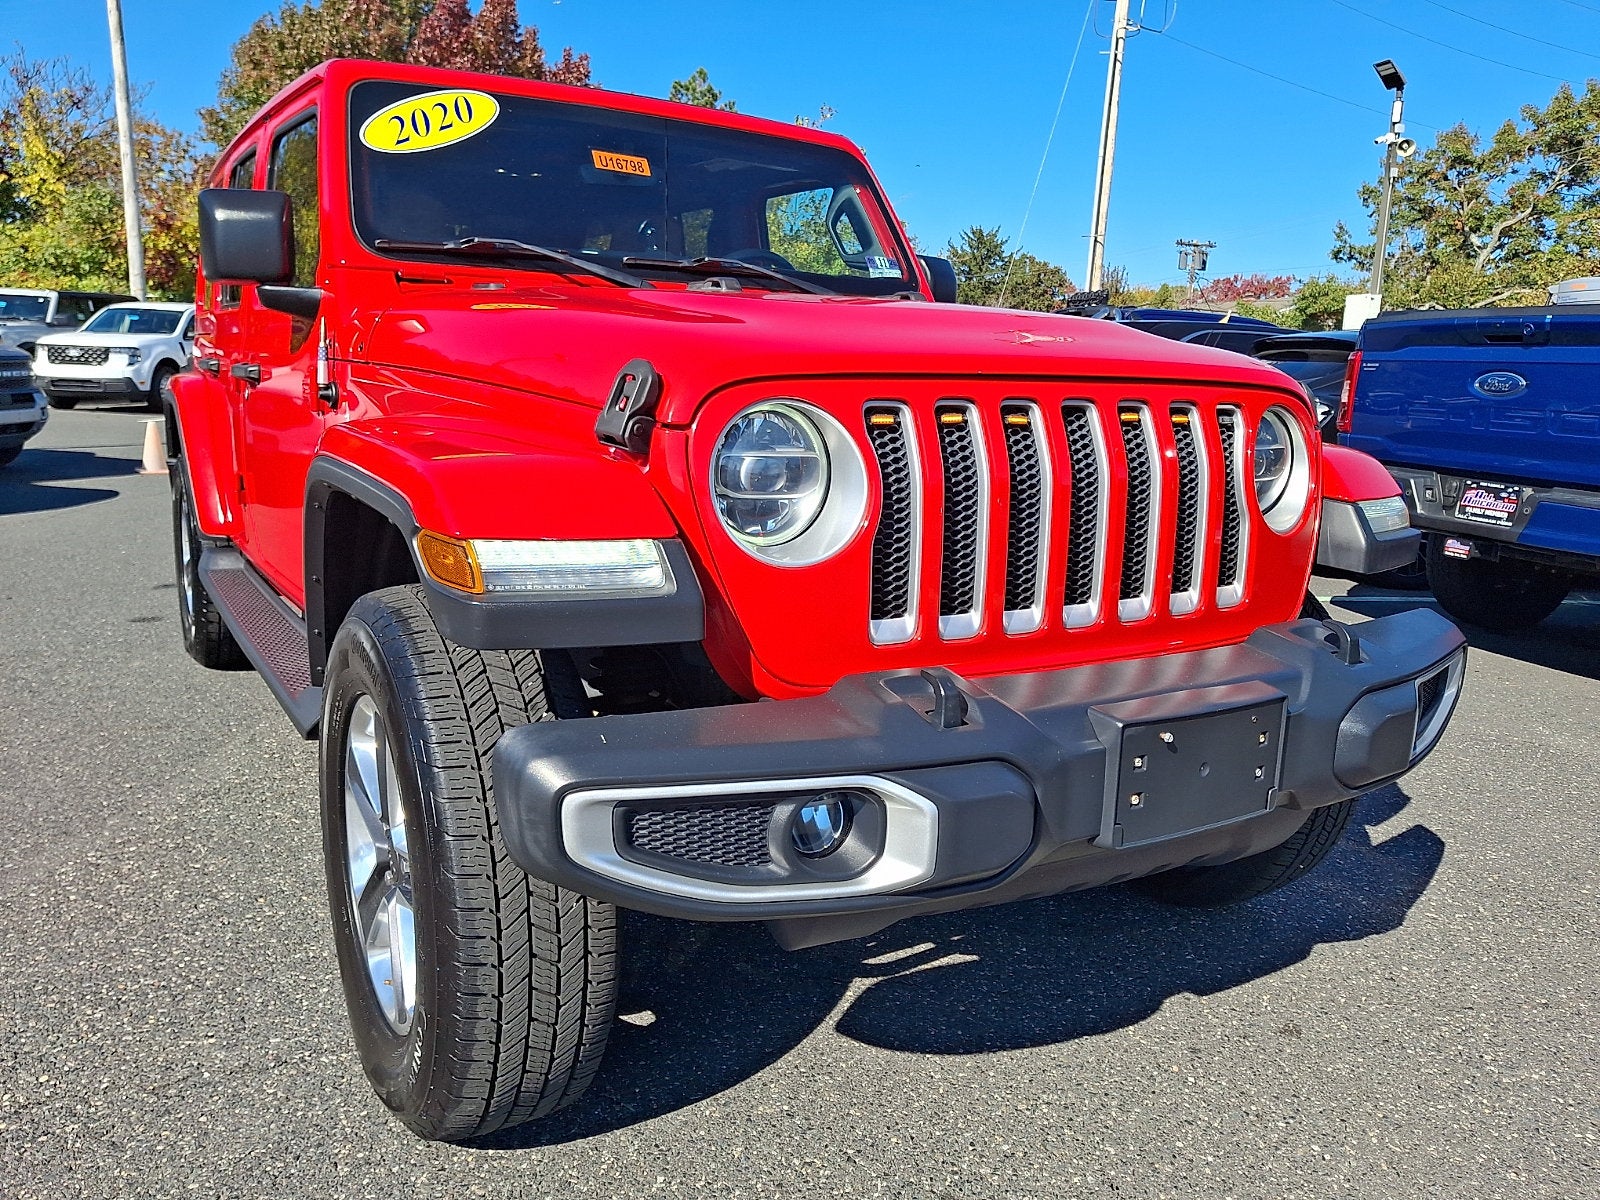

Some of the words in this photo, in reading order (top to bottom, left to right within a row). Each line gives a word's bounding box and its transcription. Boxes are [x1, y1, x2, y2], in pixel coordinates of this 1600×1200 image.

[388, 95, 474, 146] 2020
[598, 154, 645, 174] U16798
[1484, 376, 1513, 391] Ford
